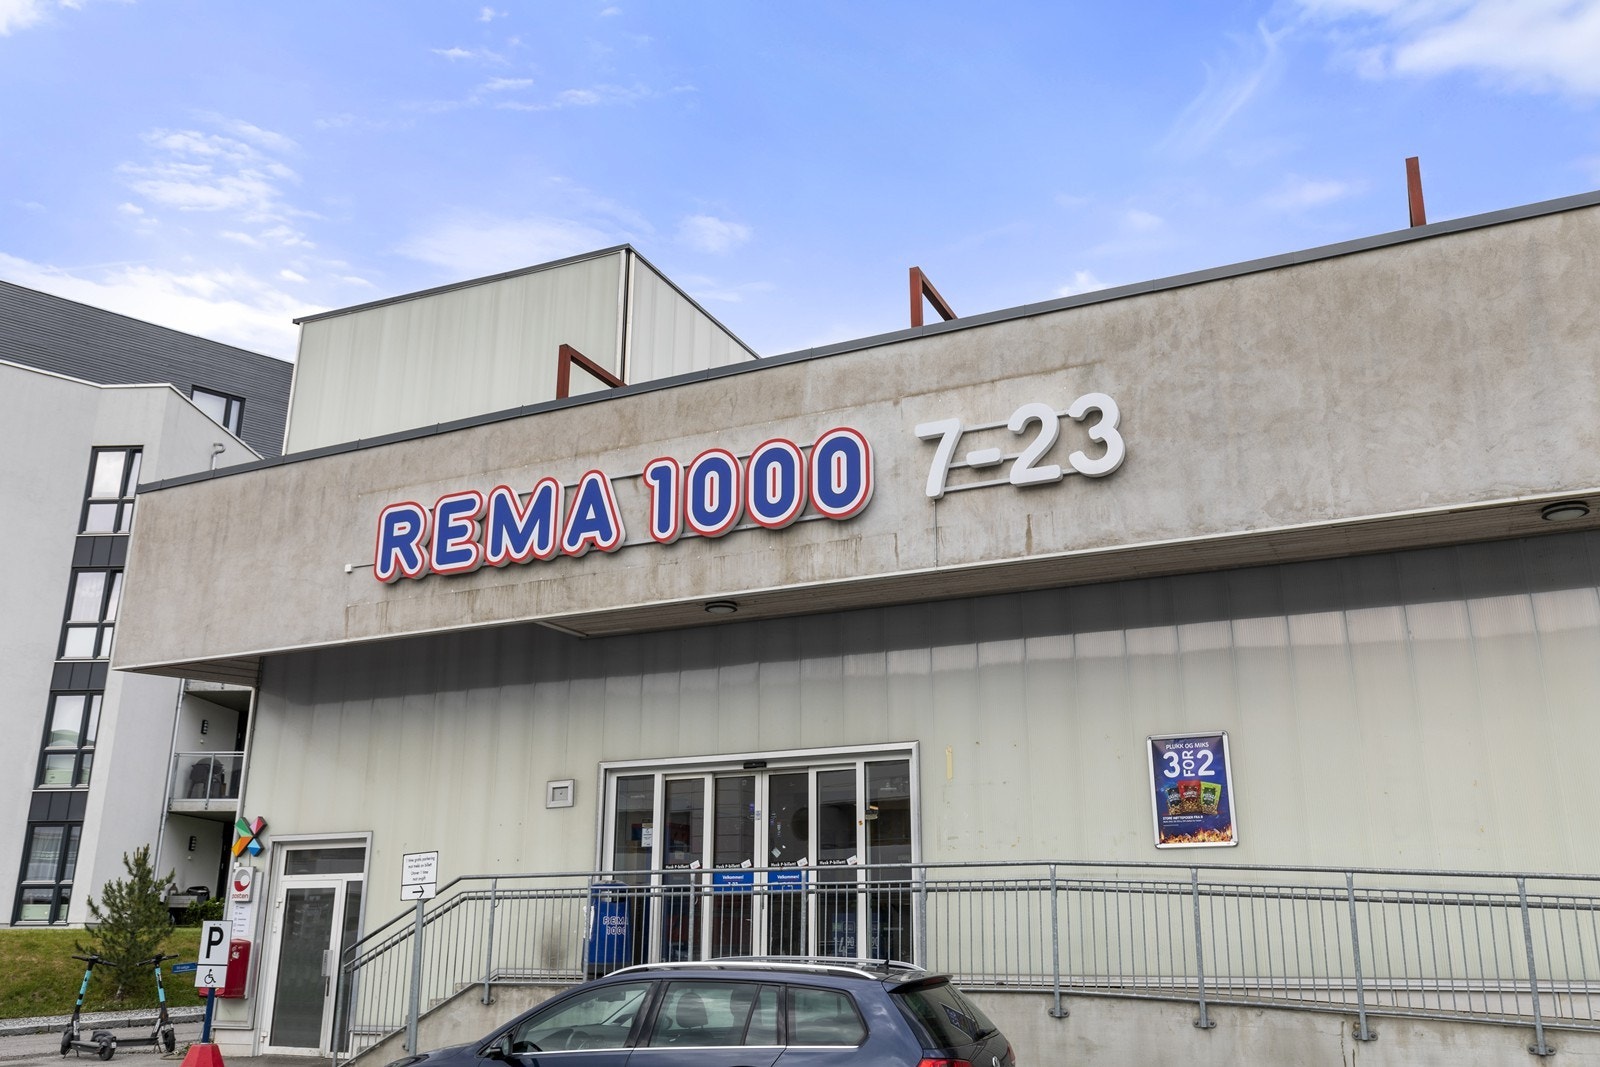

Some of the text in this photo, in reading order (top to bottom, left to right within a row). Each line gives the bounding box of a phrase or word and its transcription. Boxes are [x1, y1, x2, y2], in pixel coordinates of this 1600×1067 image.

[373, 392, 1126, 583] REMA 1000 7-23
[1163, 749, 1216, 778] 3 FOR 2
[602, 915, 628, 925] REM
[205, 926, 224, 959] P
